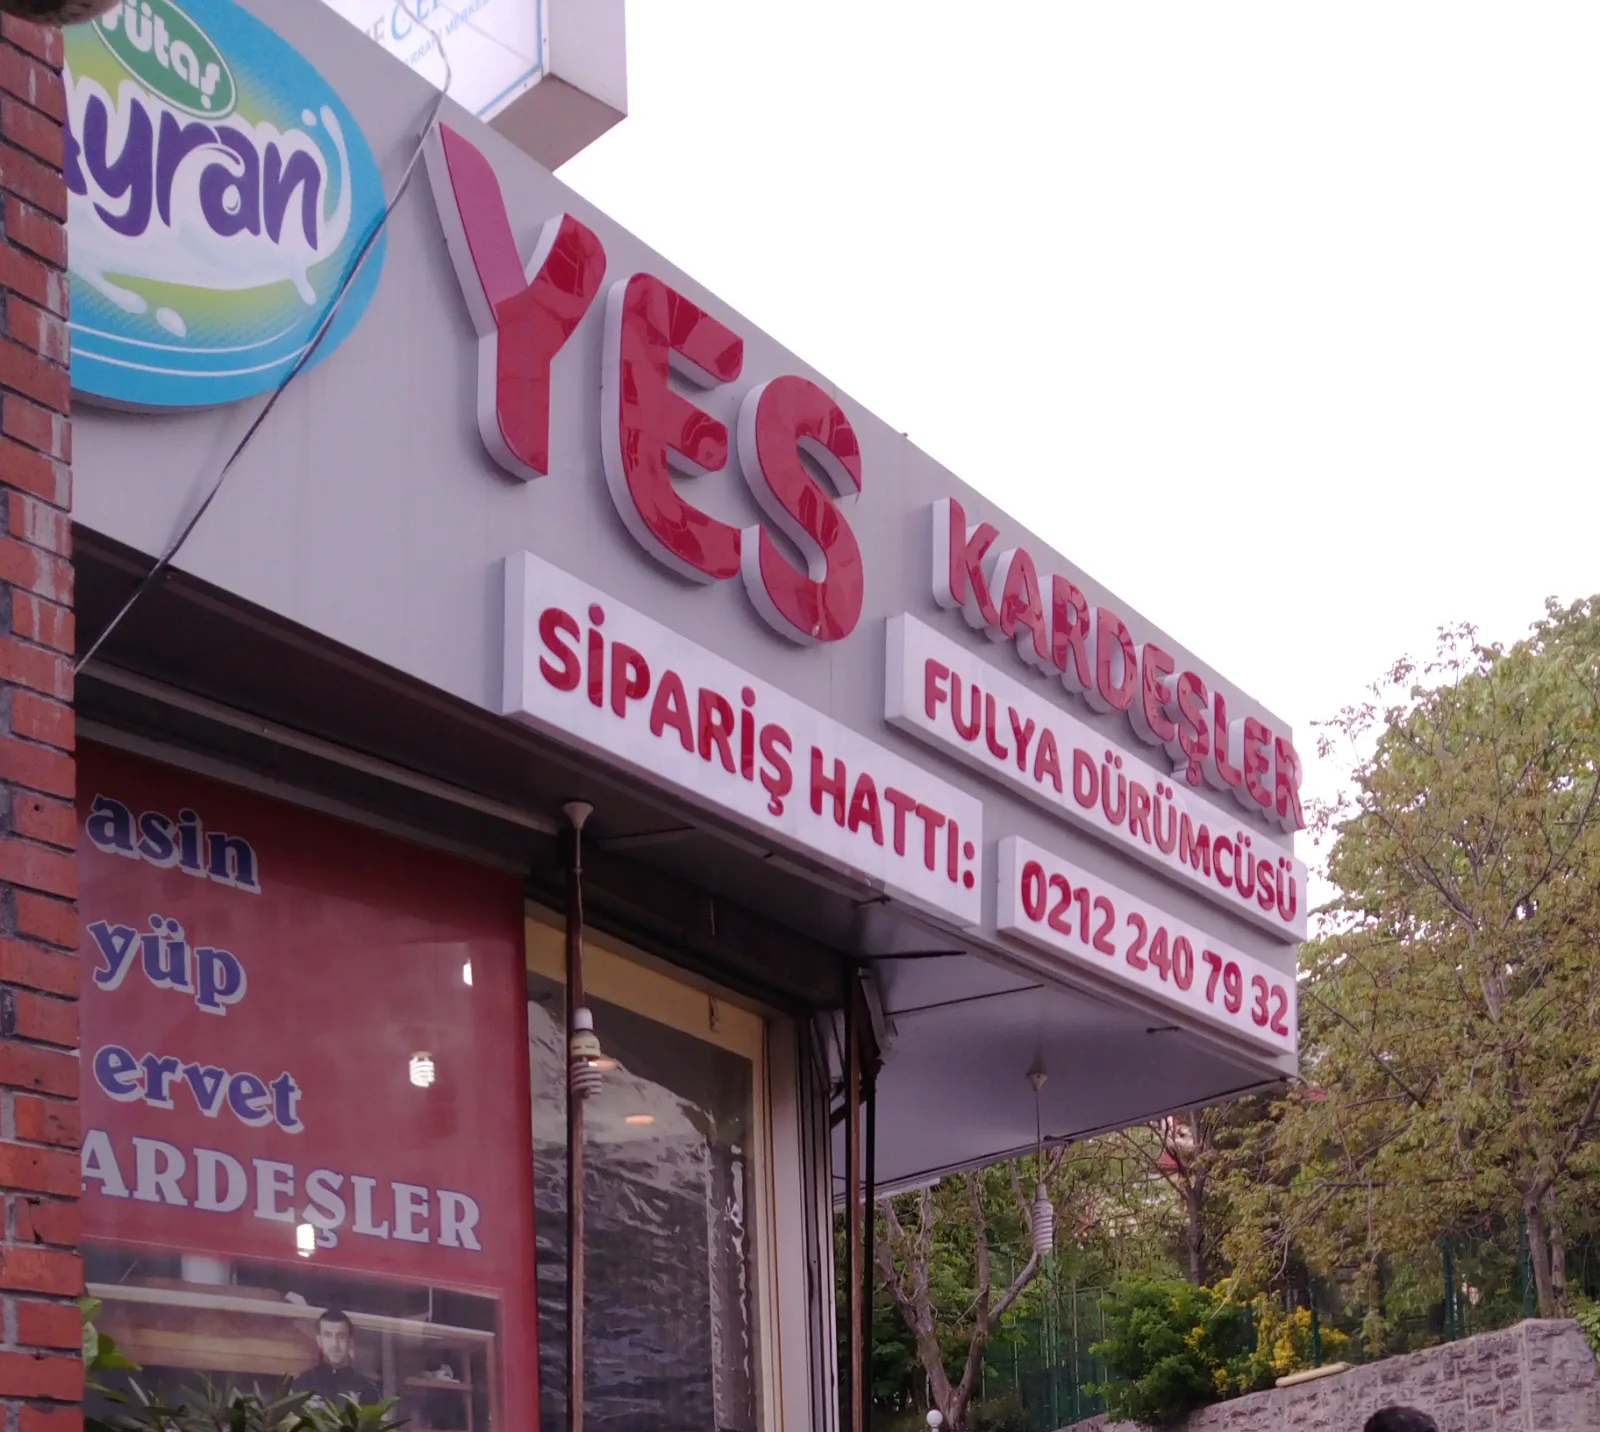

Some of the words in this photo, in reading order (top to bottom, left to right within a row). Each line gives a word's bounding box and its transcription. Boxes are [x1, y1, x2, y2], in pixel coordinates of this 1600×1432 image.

[432, 122, 863, 643] YES
[538, 602, 794, 816] SİPARİŞ
[810, 745, 976, 890] HATTI:
[924, 657, 1063, 794] FULYA
[1072, 749, 1298, 922] DÜRÜMCÜSÜ
[938, 498, 1305, 830] KARDEŞLER
[1021, 859, 1117, 957] 0212
[1126, 911, 1195, 991] 240
[1202, 949, 1244, 1015] 79
[1251, 974, 1289, 1037] 32
